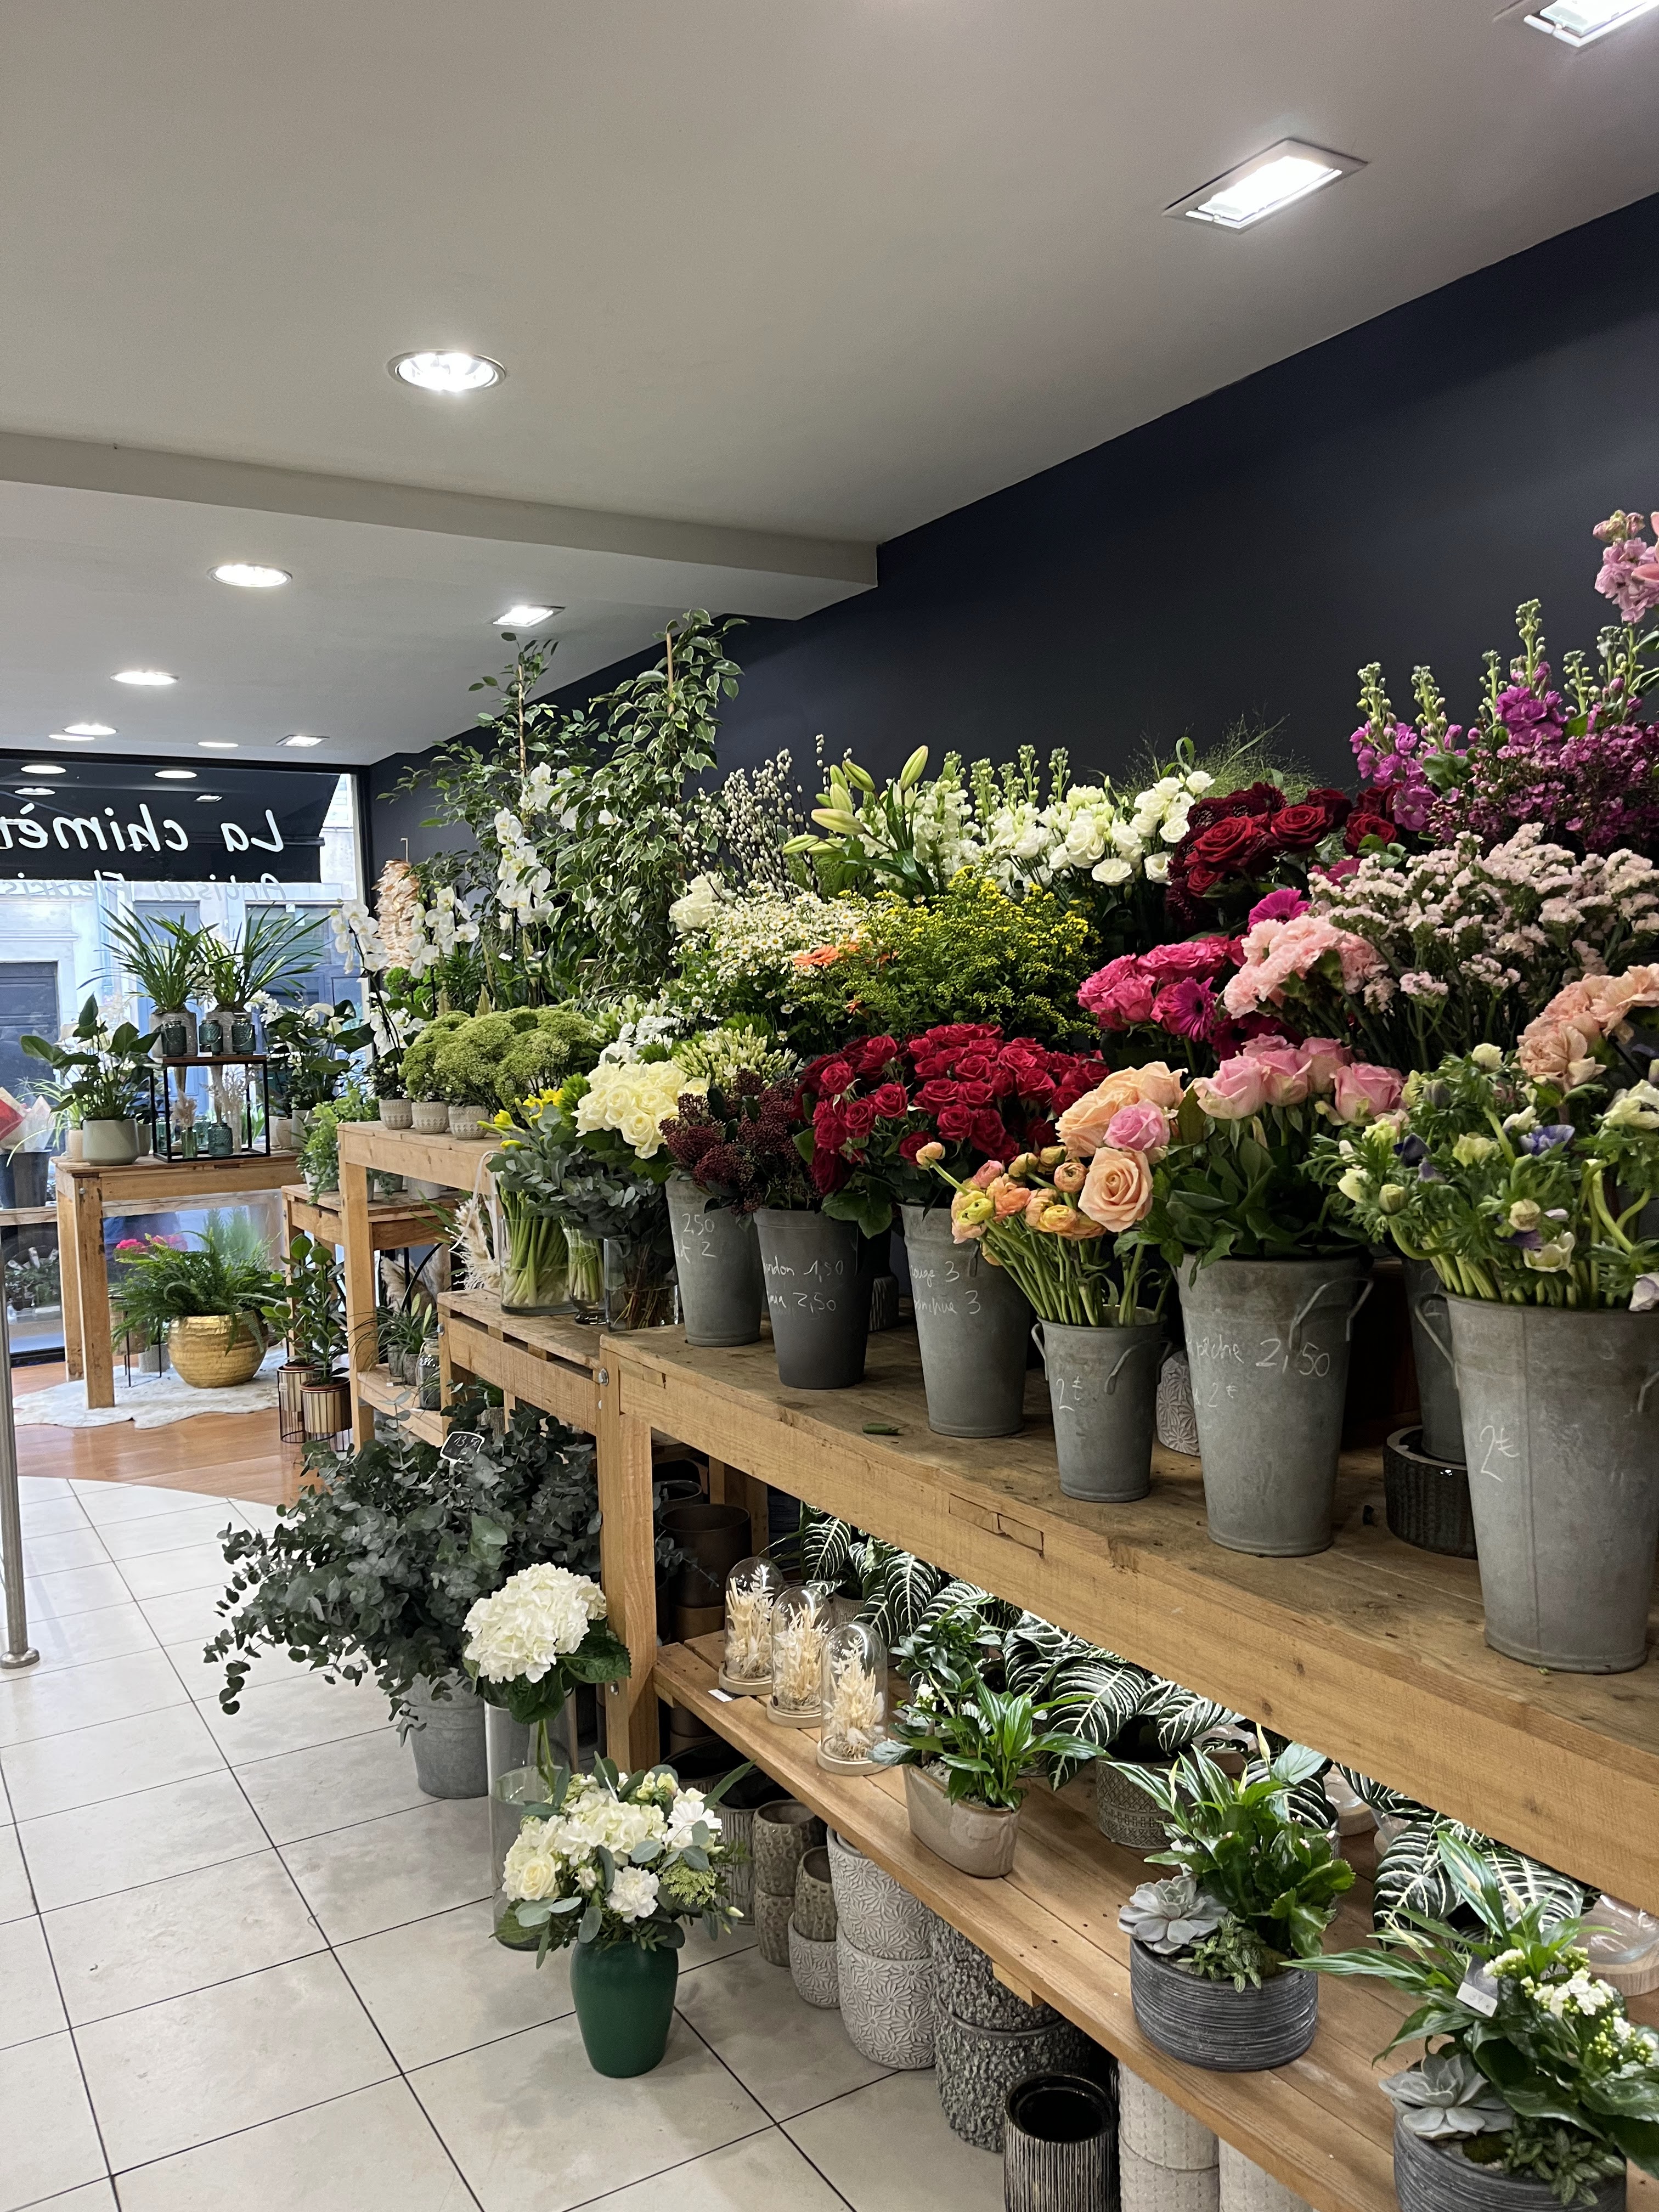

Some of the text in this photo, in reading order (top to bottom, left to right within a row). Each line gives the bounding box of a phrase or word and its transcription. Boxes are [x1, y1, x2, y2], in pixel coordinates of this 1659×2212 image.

[701, 1241, 717, 1258] 2
[803, 1260, 844, 1283] 1,50
[944, 1260, 960, 1283] 3
[792, 1291, 837, 1314] 2,50
[964, 1290, 981, 1314] 3
[1255, 1337, 1330, 1378] 2,50
[453, 1435, 480, 1448] 13,50
